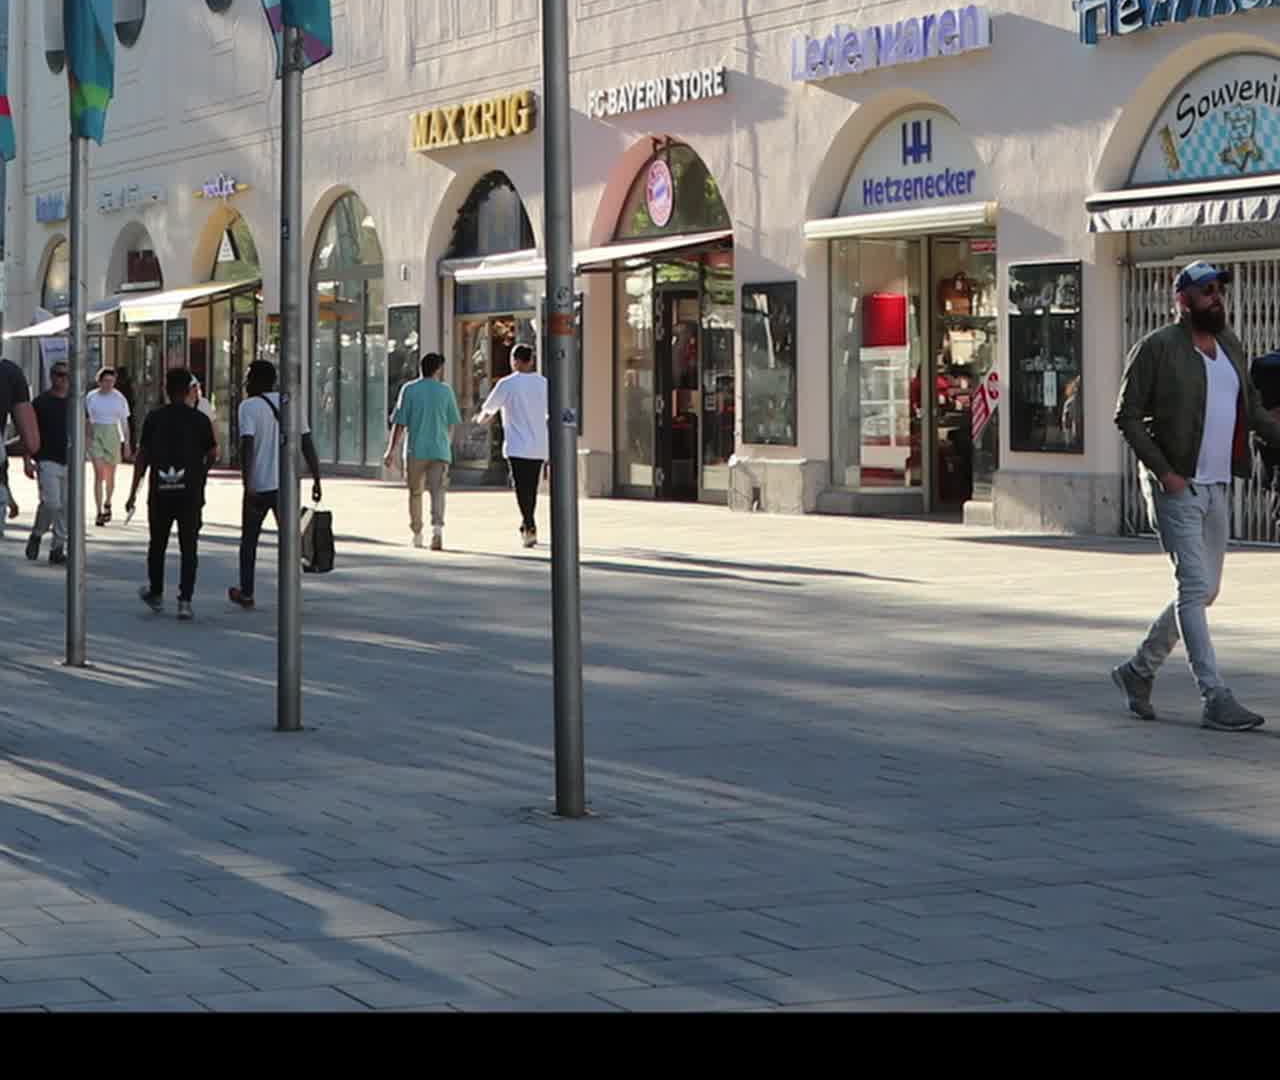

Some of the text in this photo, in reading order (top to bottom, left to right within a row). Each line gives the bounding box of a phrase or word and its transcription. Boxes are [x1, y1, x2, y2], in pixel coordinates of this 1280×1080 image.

[791, 4, 994, 82] Lederwaren
[607, 77, 669, 115] BAYERN
[670, 66, 726, 104] STORE
[410, 89, 535, 152] MAX KRUG
[862, 167, 977, 207] Hetzenecker
